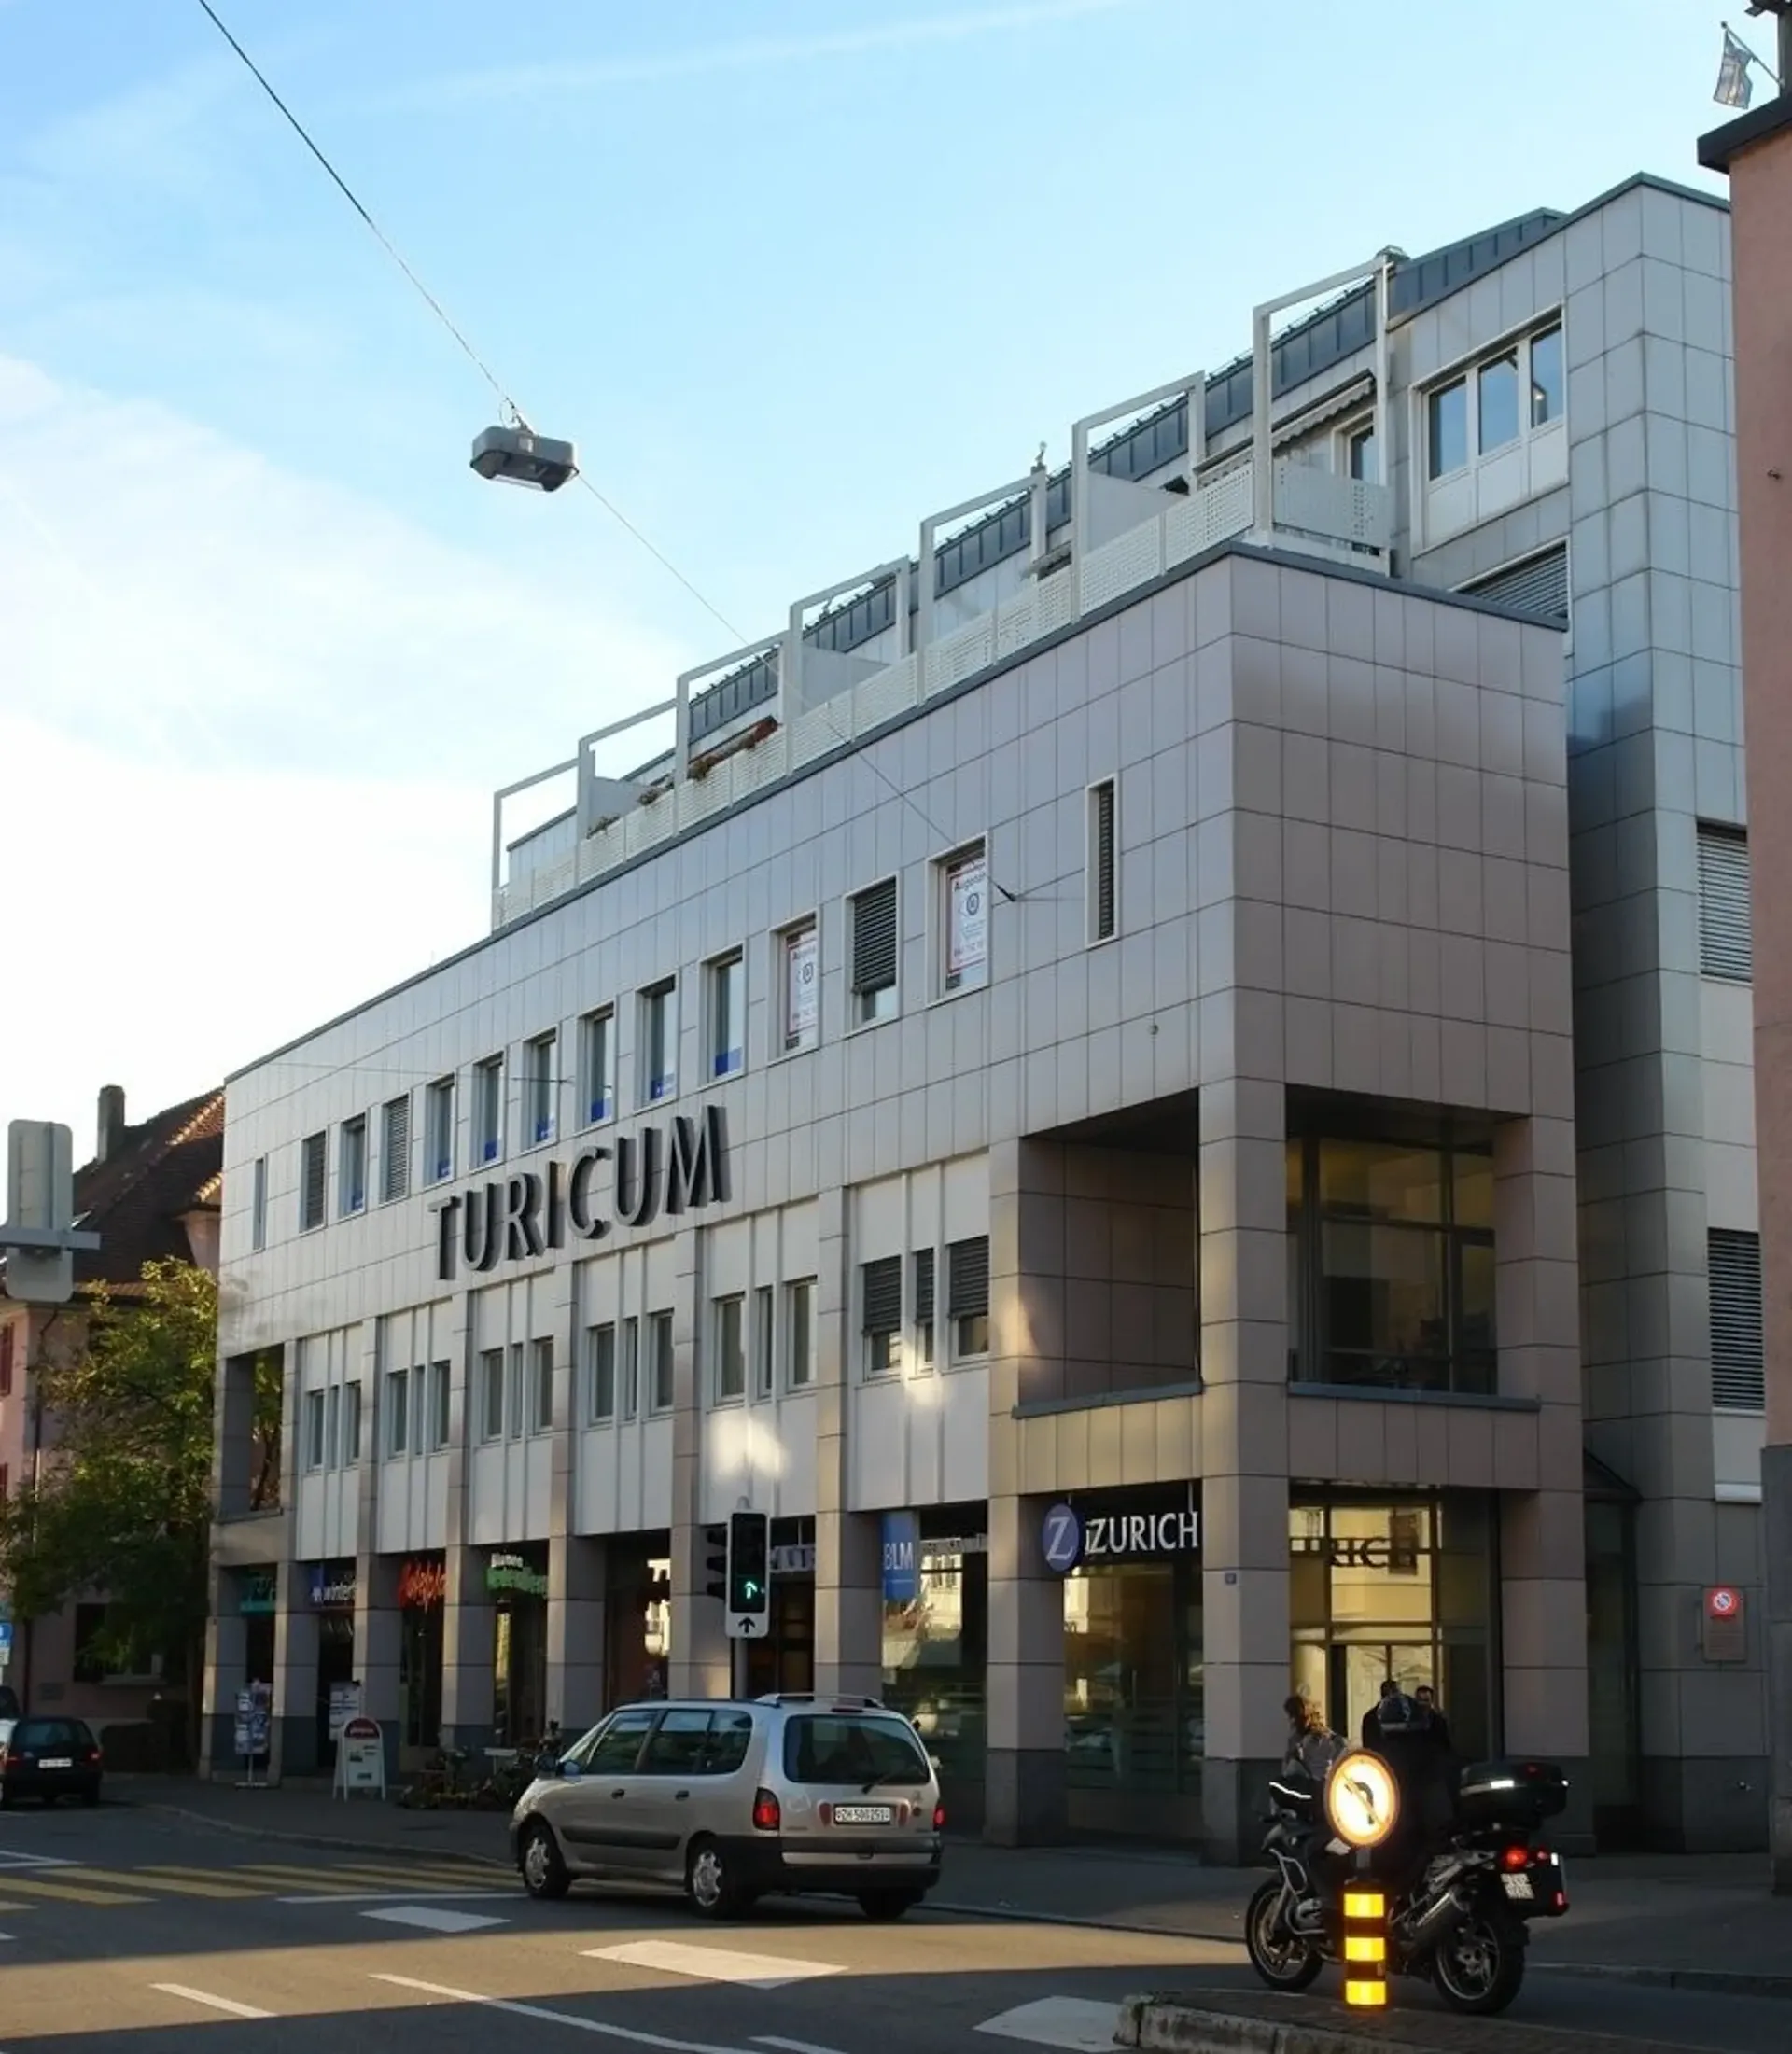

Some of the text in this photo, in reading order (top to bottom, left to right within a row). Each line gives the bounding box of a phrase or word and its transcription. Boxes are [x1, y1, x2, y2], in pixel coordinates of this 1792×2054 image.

[428, 1105, 732, 1280] TURICUM
[884, 1541, 914, 1570] BLM
[1045, 1511, 1198, 1561] Z ZURICH
